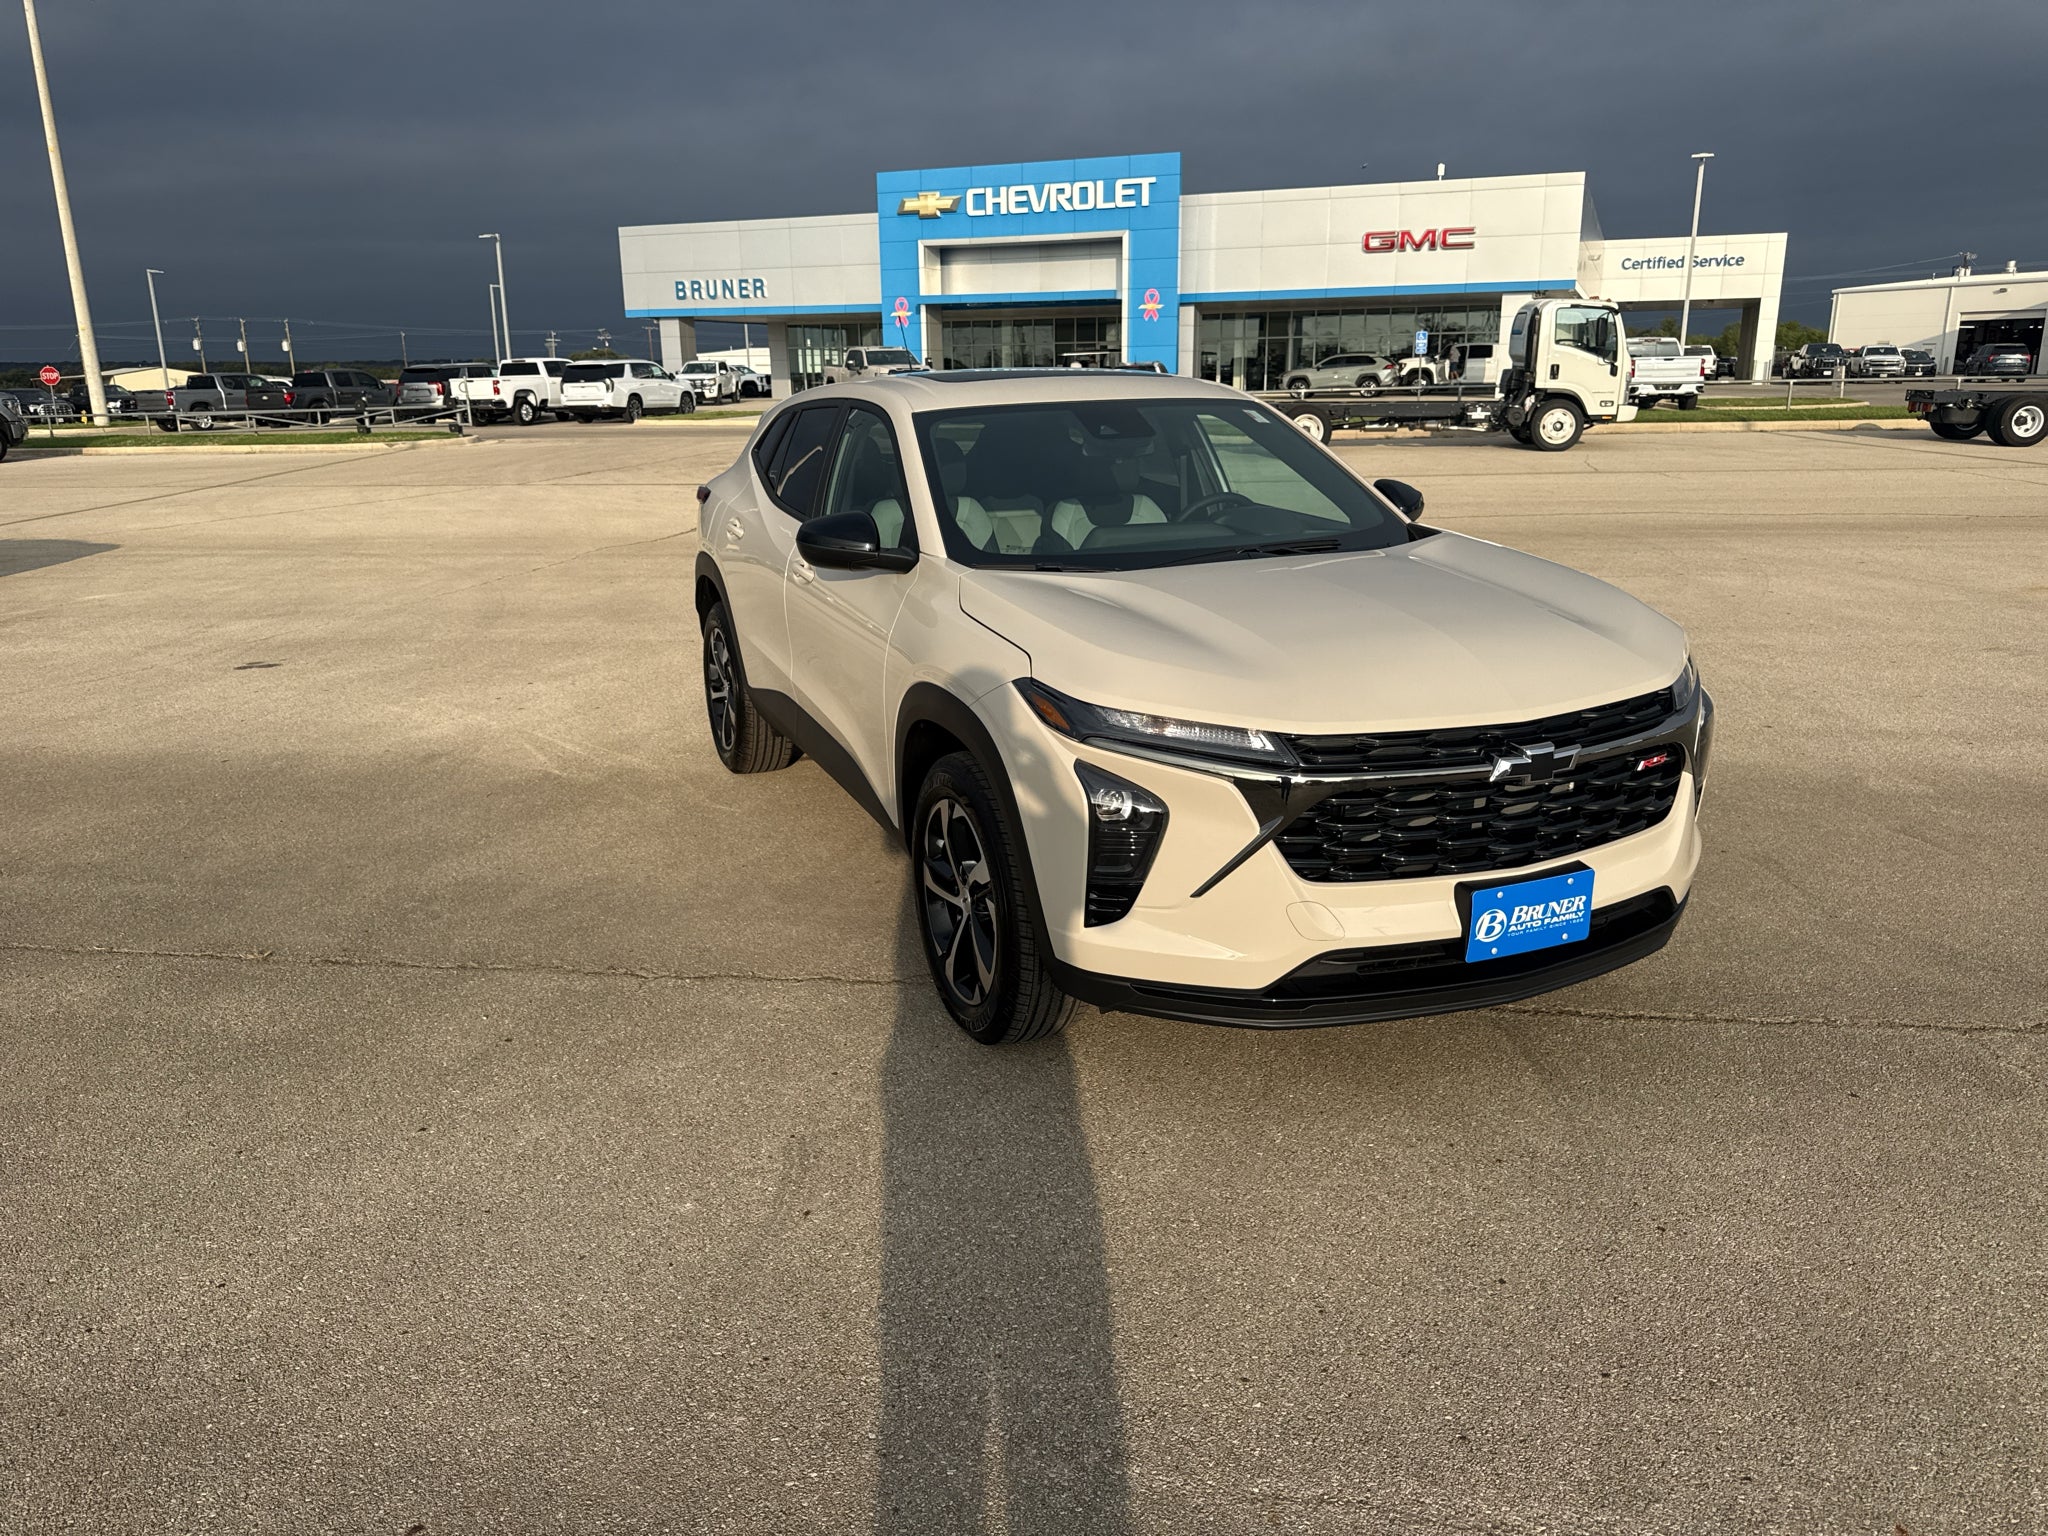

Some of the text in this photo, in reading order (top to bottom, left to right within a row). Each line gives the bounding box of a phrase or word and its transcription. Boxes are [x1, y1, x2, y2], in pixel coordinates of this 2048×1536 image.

[966, 176, 1157, 216] CHEVROLET
[1362, 226, 1476, 253] GMC
[1621, 254, 1745, 270] Certified Service
[674, 278, 768, 300] BRUNER
[42, 372, 58, 380] STOP
[1509, 895, 1587, 925] BRUNER
[1508, 911, 1585, 932] AUTO FAMILY
